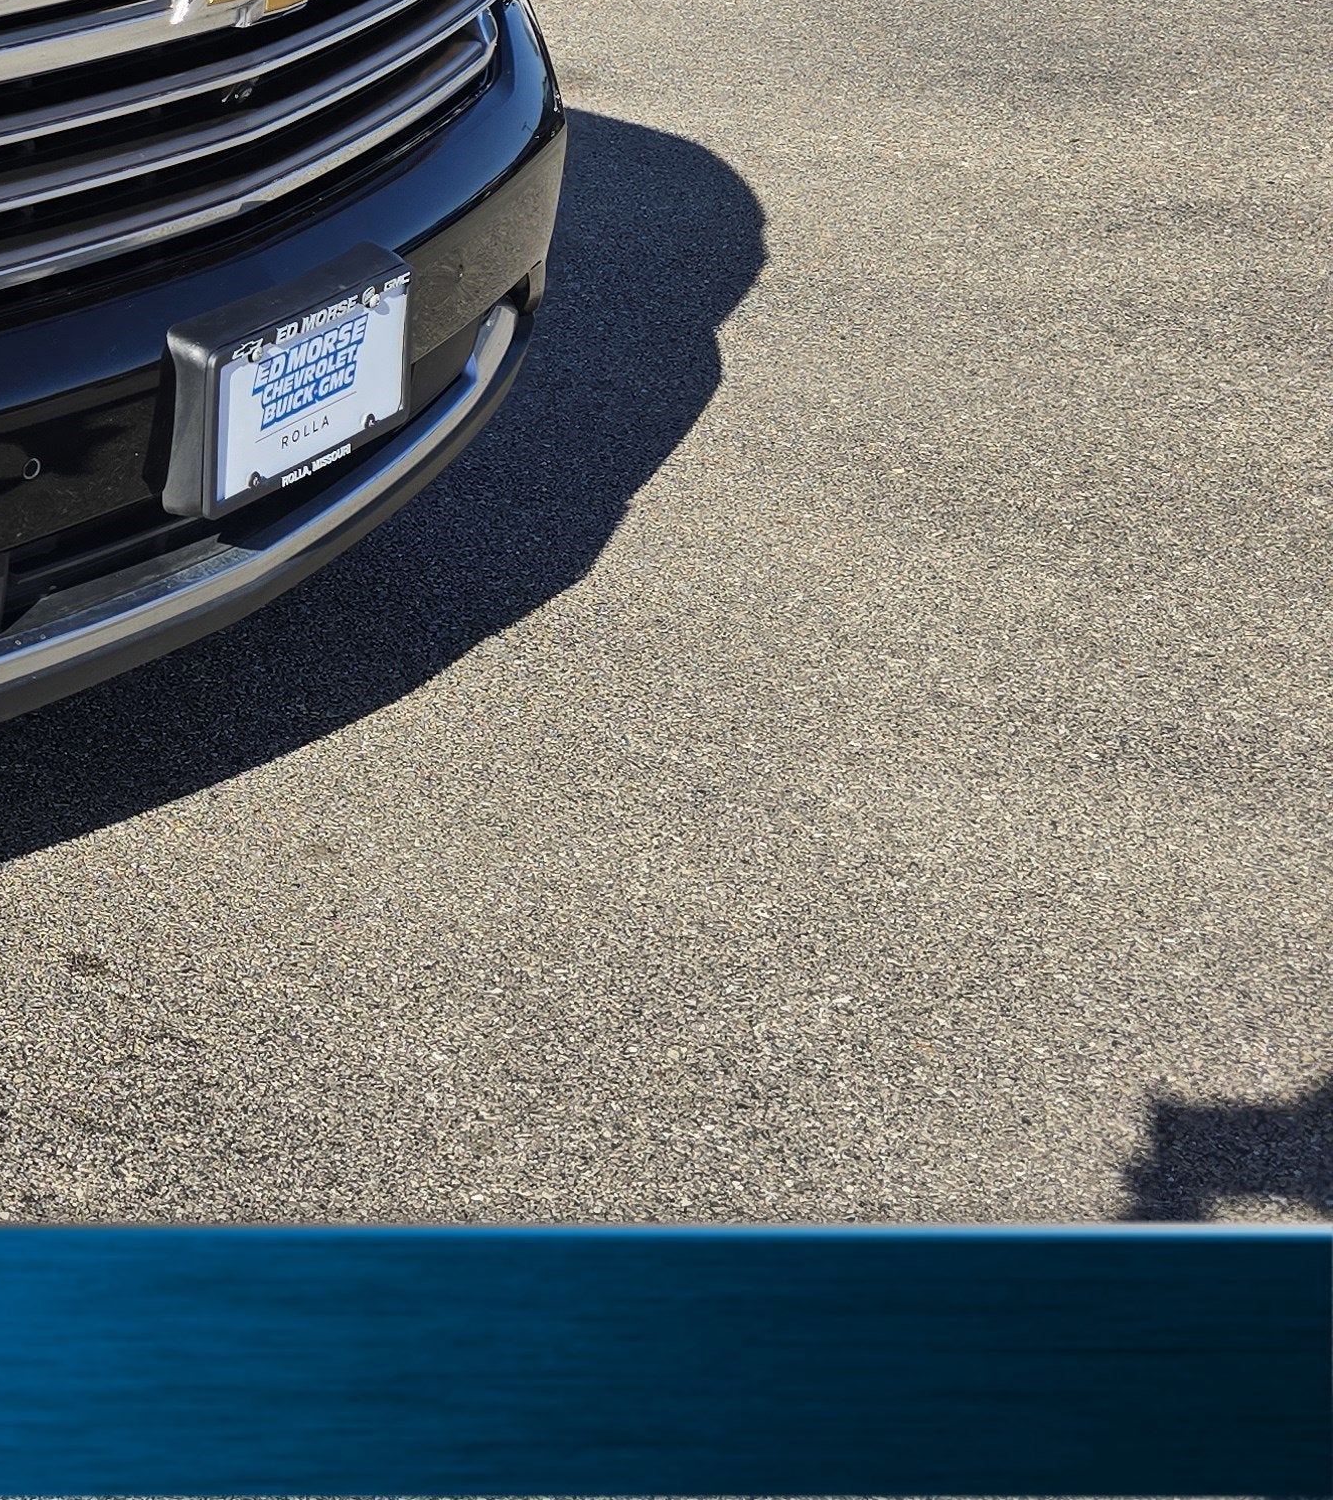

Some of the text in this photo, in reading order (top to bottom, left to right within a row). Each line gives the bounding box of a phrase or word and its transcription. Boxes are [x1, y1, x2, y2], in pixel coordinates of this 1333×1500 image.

[383, 271, 411, 293] GMC
[275, 294, 360, 345] ED MORSE
[254, 314, 368, 389] ED MORSE
[262, 344, 358, 406] CHEVROLET
[281, 415, 330, 450] ROLLA
[311, 443, 352, 472] MISSOURI
